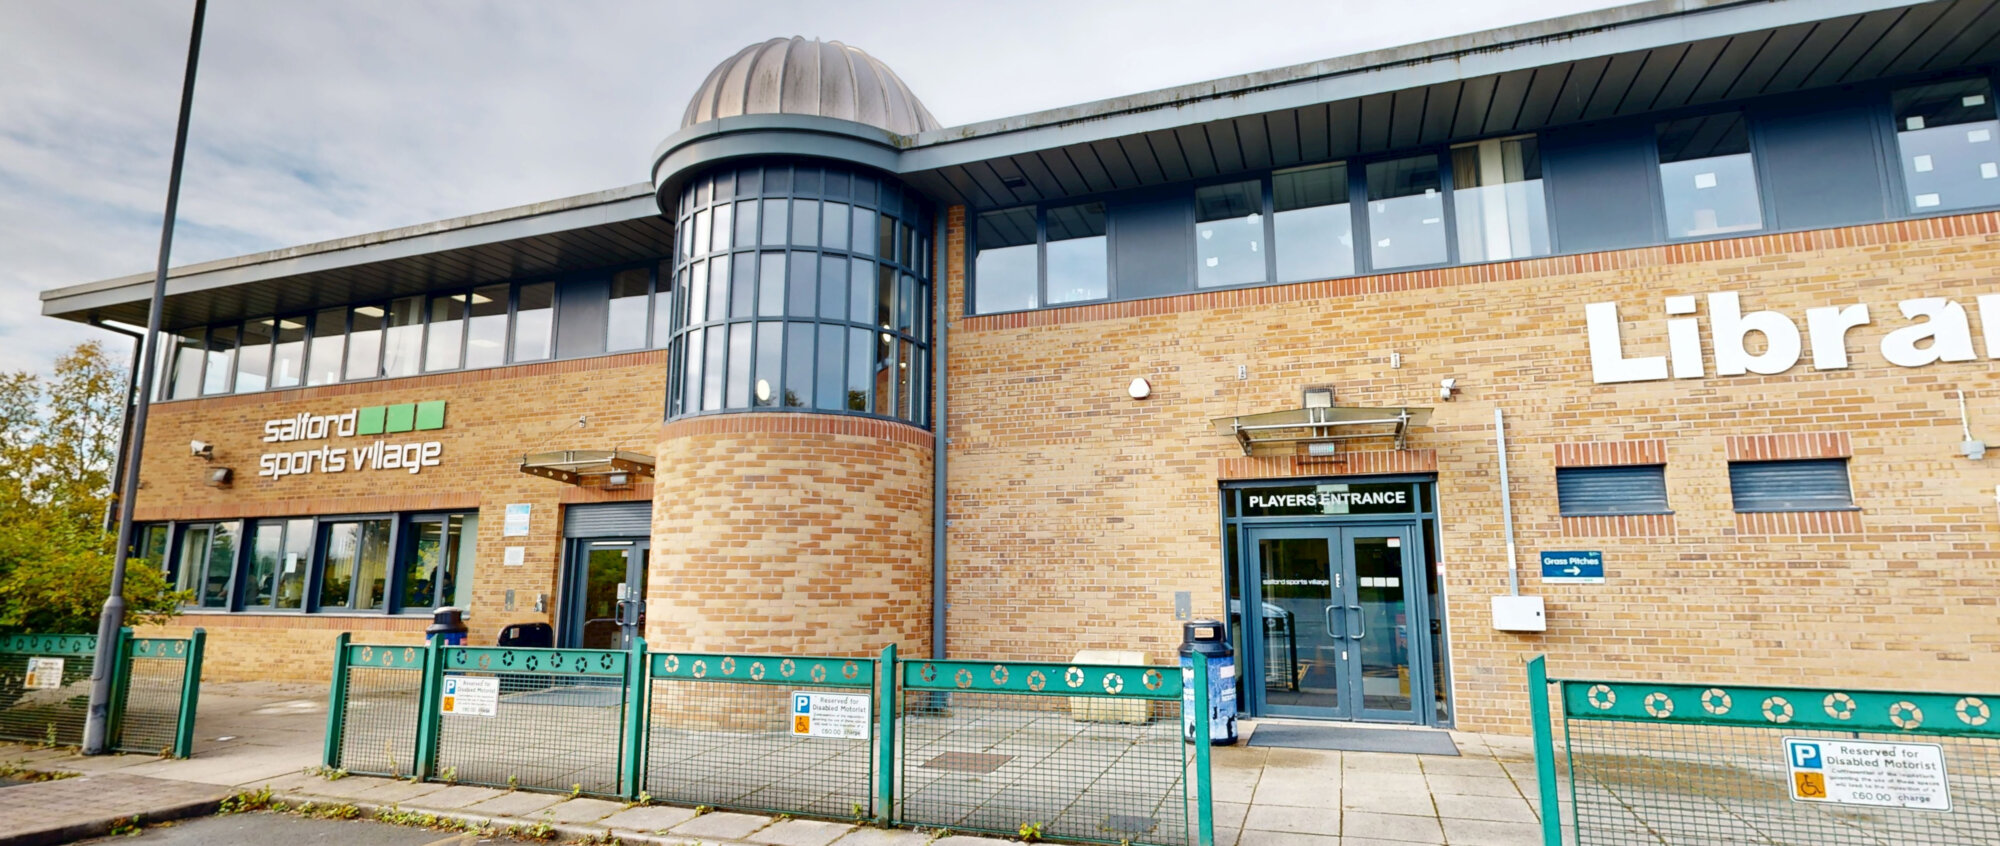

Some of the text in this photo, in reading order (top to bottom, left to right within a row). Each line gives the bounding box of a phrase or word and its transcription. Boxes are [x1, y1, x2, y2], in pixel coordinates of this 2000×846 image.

[263, 408, 357, 443] salford
[258, 440, 442, 481] sports village
[1249, 491, 1407, 508] PLAYERS ENTRANCE
[1543, 557, 1599, 565] Grass Pitches
[796, 697, 809, 712] P
[1794, 744, 1817, 767] P
[1840, 746, 1919, 758] Reserved for
[1827, 756, 1937, 771] Disabled Motorist
[1897, 794, 1931, 803] charge
